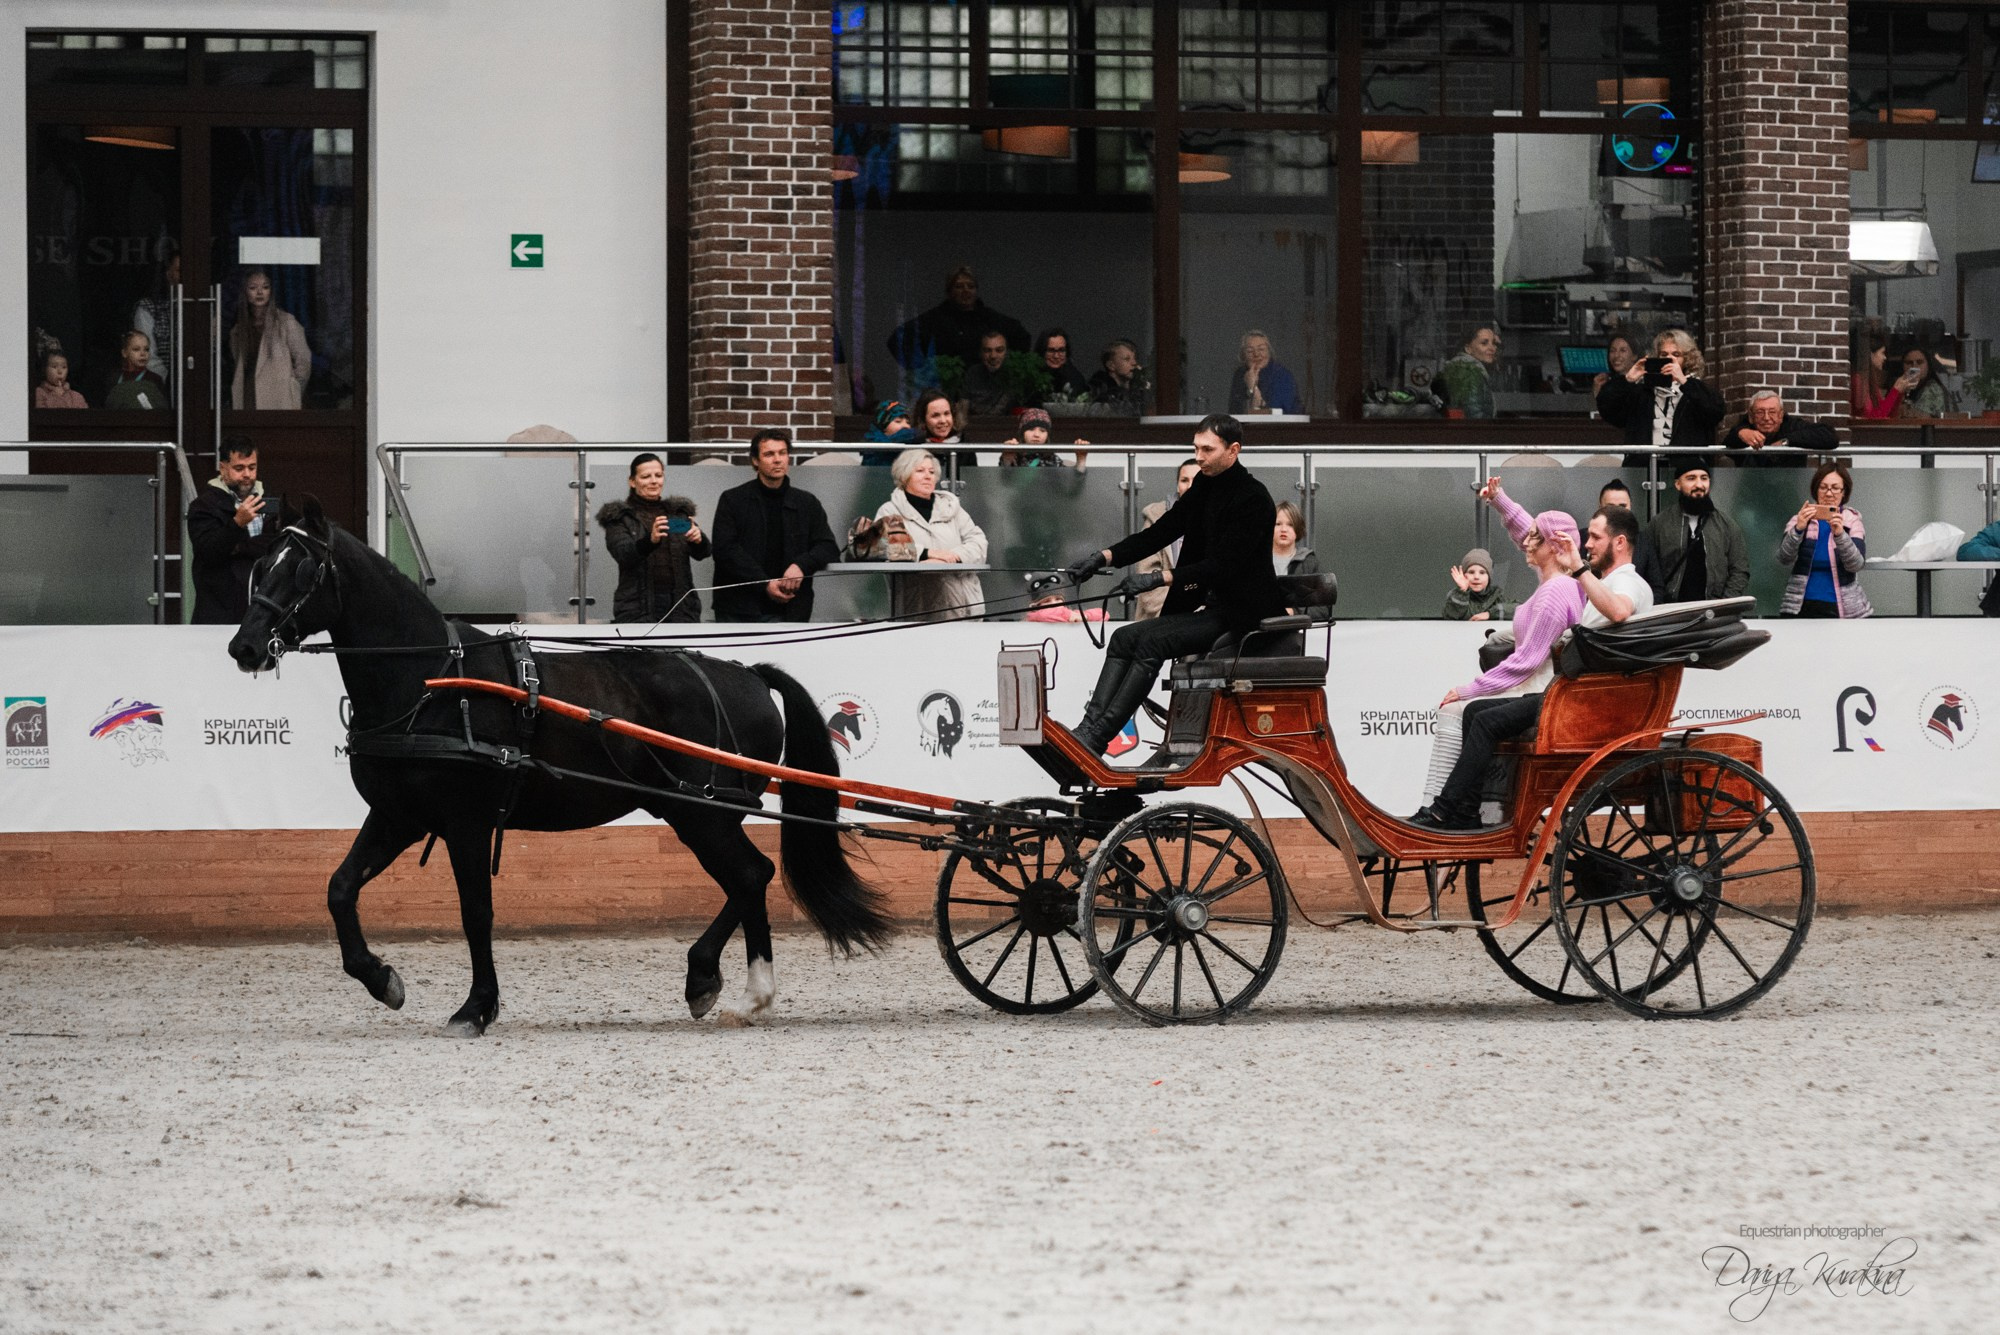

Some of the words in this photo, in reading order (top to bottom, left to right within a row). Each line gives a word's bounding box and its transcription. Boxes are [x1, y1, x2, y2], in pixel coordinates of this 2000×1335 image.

[87, 236, 218, 264] SHO
[1360, 708, 1438, 721] КРЫЛАТЫЙ
[204, 717, 289, 729] КРЫЛАТЫЙ
[204, 730, 291, 745] ЭКЛИПС
[6, 748, 49, 756] КОННАЯ
[6, 758, 50, 766] РОССИЯ
